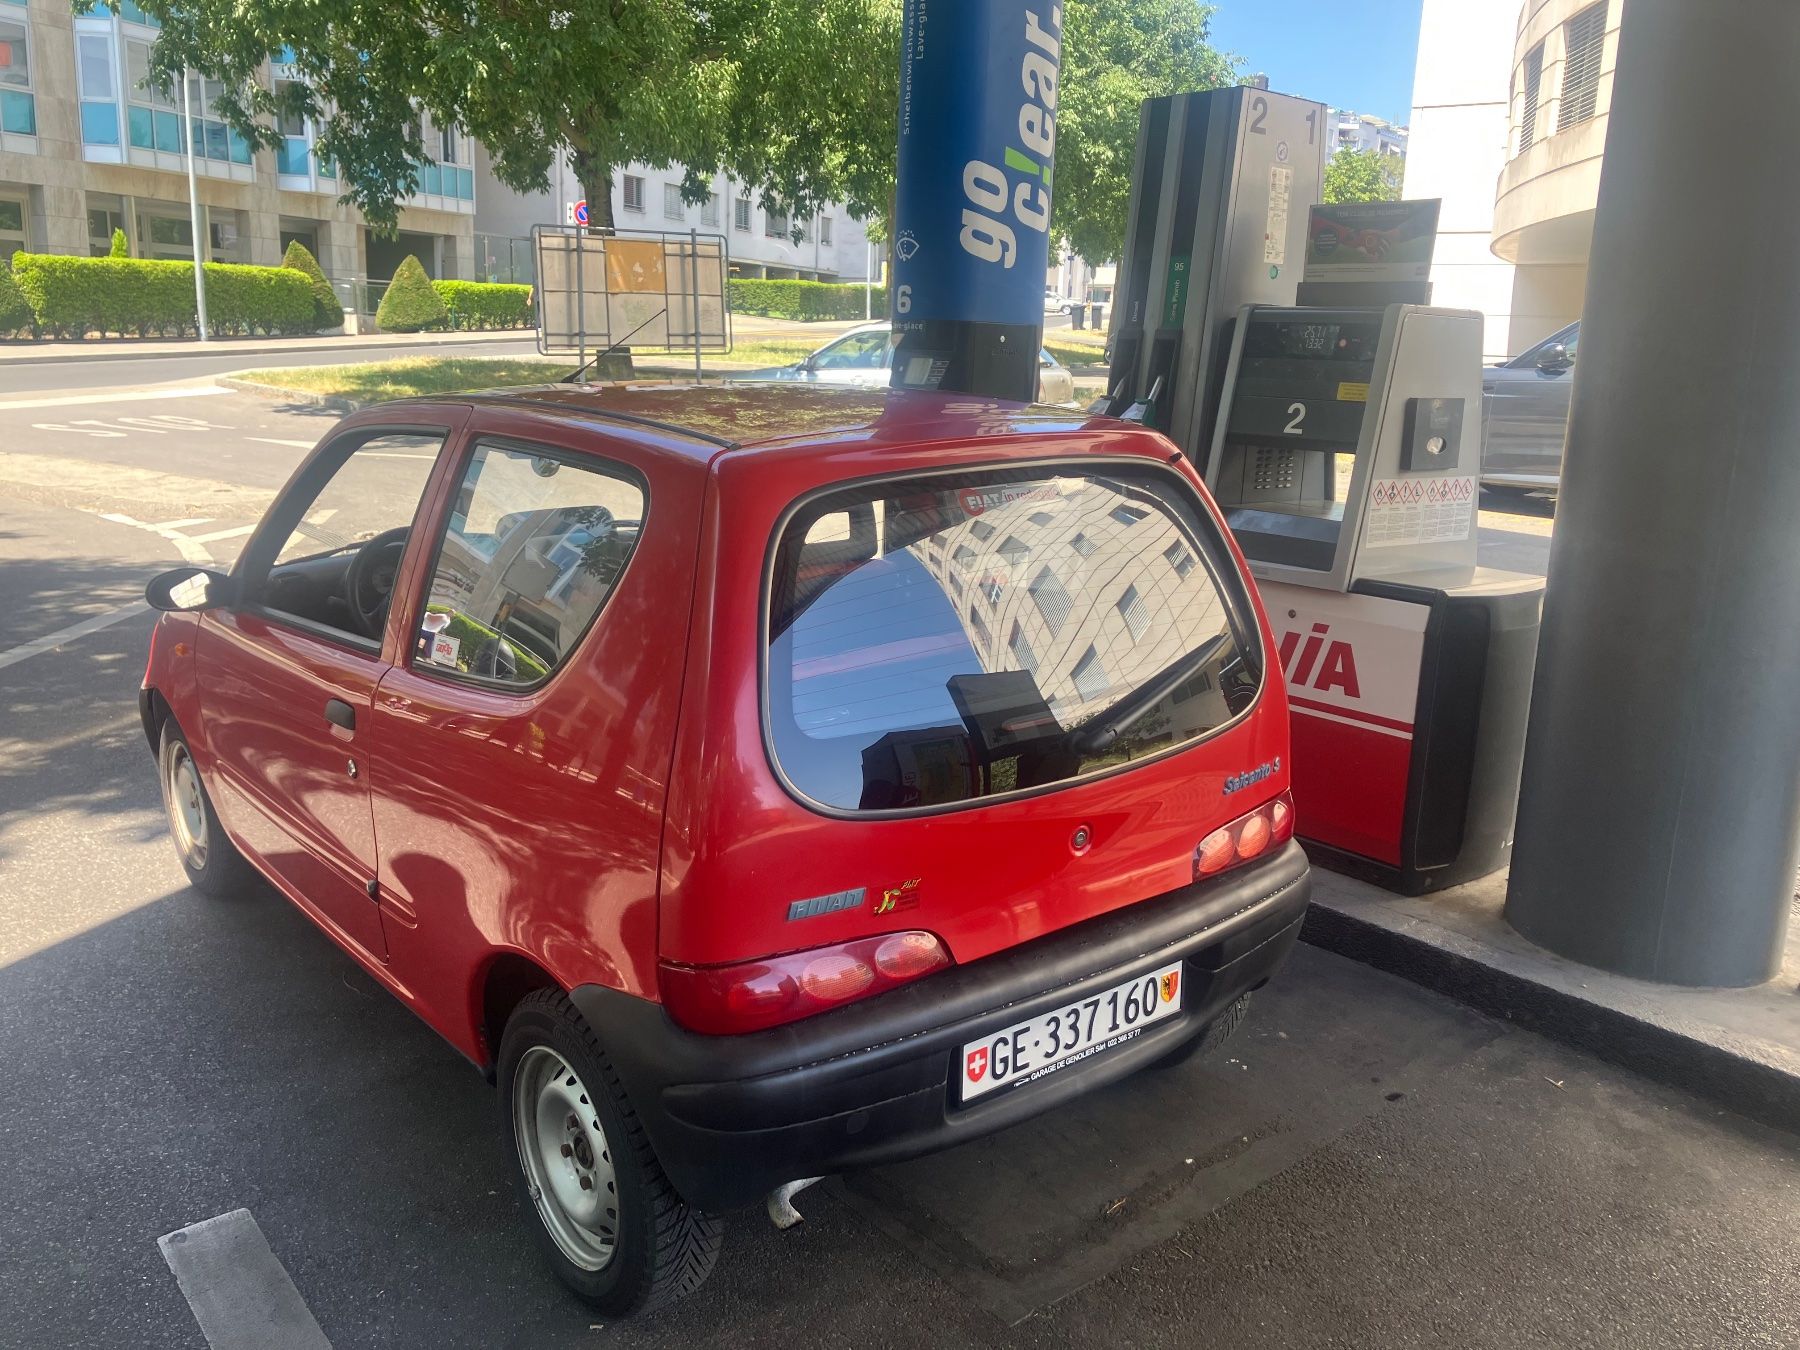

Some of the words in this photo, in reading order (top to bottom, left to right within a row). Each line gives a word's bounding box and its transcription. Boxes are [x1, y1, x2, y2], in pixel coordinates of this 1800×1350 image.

[915, 0, 927, 60] Lave-gla
[1250, 97, 1268, 135] 2
[1305, 109, 1316, 145] 1
[959, 160, 1017, 269] go
[1174, 262, 1184, 271] 95
[897, 285, 912, 314] 6
[1283, 402, 1306, 434] 2
[966, 493, 999, 509] FIAT
[1004, 491, 1014, 502] in
[792, 891, 863, 918] FIAT
[1031, 1063, 1057, 1081] GARAGE
[1056, 1059, 1066, 1070] DE
[1065, 1048, 1095, 1065] GENOLIER
